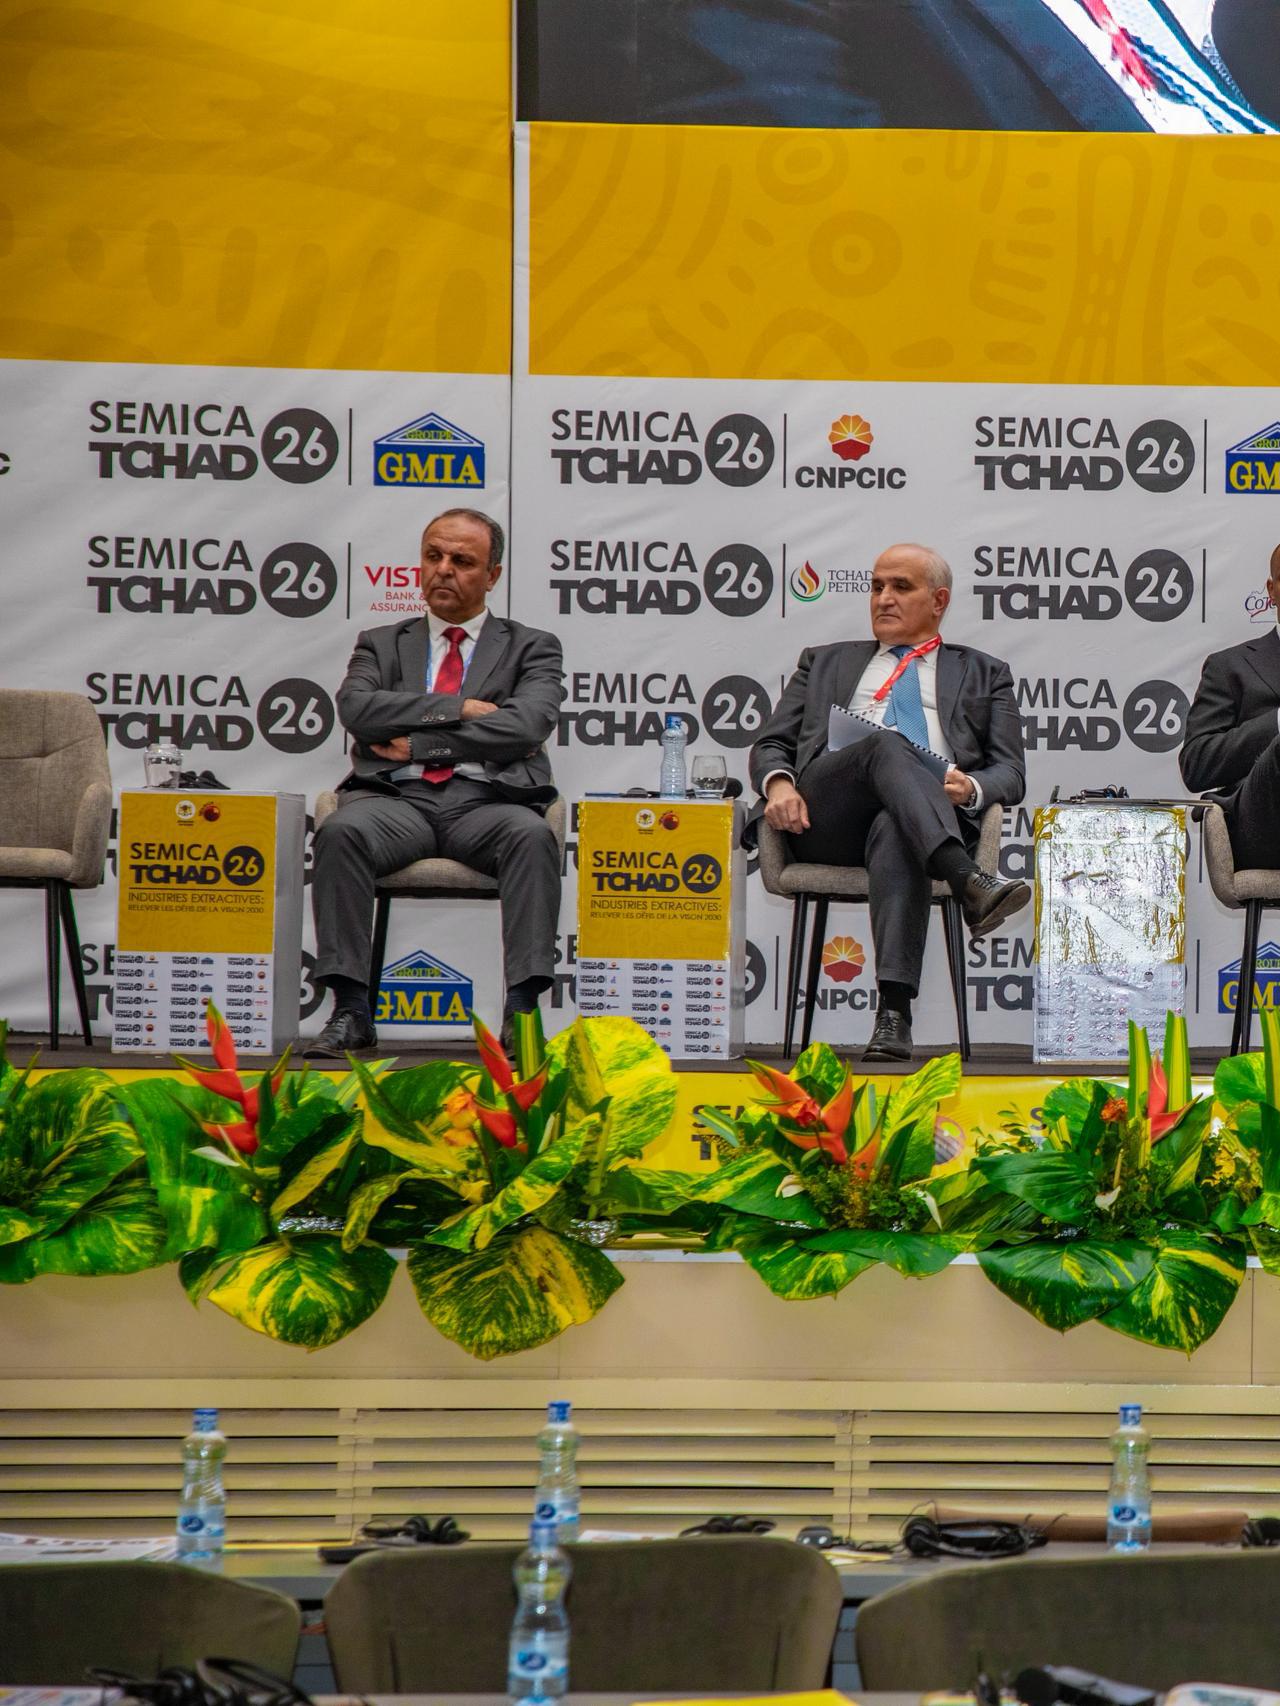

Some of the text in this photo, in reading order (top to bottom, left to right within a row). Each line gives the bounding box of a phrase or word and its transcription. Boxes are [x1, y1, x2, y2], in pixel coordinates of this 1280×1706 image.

[90, 401, 254, 437] SEMICA
[405, 429, 454, 441] GROUPE
[552, 410, 698, 442] SEMICA
[976, 417, 1120, 448] SEMICA
[89, 441, 258, 480] TCHAD
[273, 427, 326, 465] 26
[716, 432, 763, 469] 26
[1137, 438, 1184, 475] 26
[377, 452, 482, 484] GMIA
[551, 448, 702, 484] TCHAD
[795, 467, 907, 489] CNPCIC
[975, 454, 1123, 490] TCHAD
[88, 536, 253, 571] SEMICA
[551, 540, 697, 572] SEMICA
[975, 546, 1119, 578] SEMICA
[272, 561, 325, 599] 26
[364, 566, 422, 588] VIST
[714, 562, 762, 599] 26
[827, 570, 874, 581] TCHAD
[1135, 567, 1182, 604] 26
[87, 576, 257, 615] TCHAD
[370, 603, 430, 612] ASSURANC
[385, 592, 415, 600] BANK
[550, 578, 701, 615] TCHAD
[974, 584, 1122, 620] TCHAD
[86, 672, 250, 707] SEMICA
[1017, 678, 1117, 710] MICA
[269, 697, 322, 735] 26
[713, 694, 760, 730] 26
[1134, 698, 1181, 735] 26
[1022, 716, 1121, 751] HAD
[130, 842, 219, 861] SEMICA
[229, 856, 259, 876] 26
[593, 851, 678, 869] SEMICA
[130, 864, 221, 884] TCHAD
[592, 872, 680, 892] TCHAD
[688, 864, 716, 884] 26
[129, 893, 187, 903] INDUSTRIES
[591, 900, 647, 910] INDUSTRIES
[394, 967, 442, 977] GROUPE
